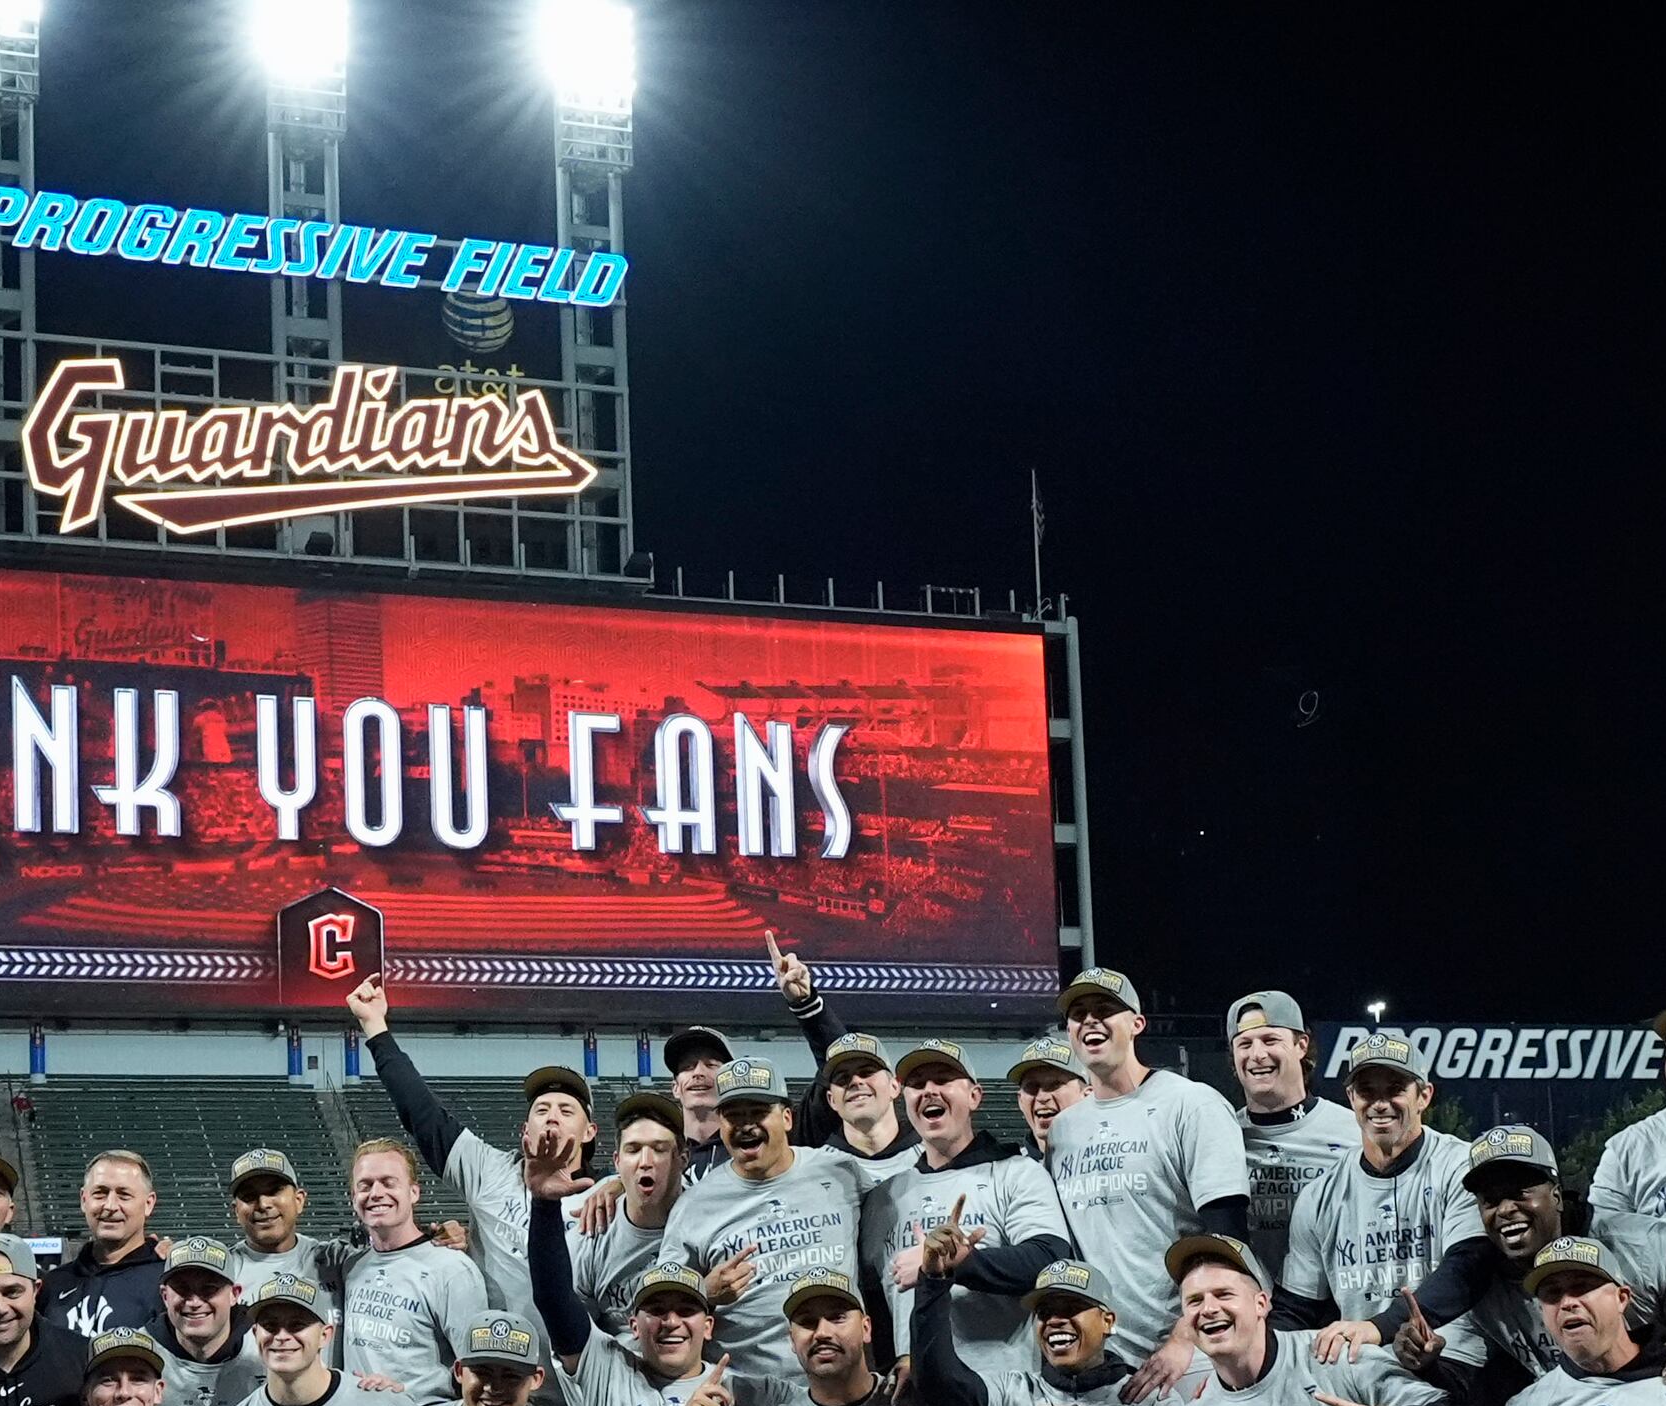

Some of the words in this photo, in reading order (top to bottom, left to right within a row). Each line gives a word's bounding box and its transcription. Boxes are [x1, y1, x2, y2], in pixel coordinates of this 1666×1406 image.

[442, 237, 629, 308] FIELD
[21, 357, 597, 535] Guardians
[255, 693, 490, 850] YOU
[547, 709, 852, 860] FANS
[307, 912, 357, 980] C
[1324, 1026, 1666, 1080] POGRESSIVE
[1079, 1154, 1125, 1174] LEAGUE
[1081, 1140, 1149, 1161] AMERICAN
[1248, 1167, 1325, 1181] AMERICA
[756, 1211, 843, 1241] AMERICAN
[757, 1230, 823, 1255] LEAGUE
[351, 1302, 394, 1322] LEAGUE
[355, 1287, 420, 1313] AMERICAN
